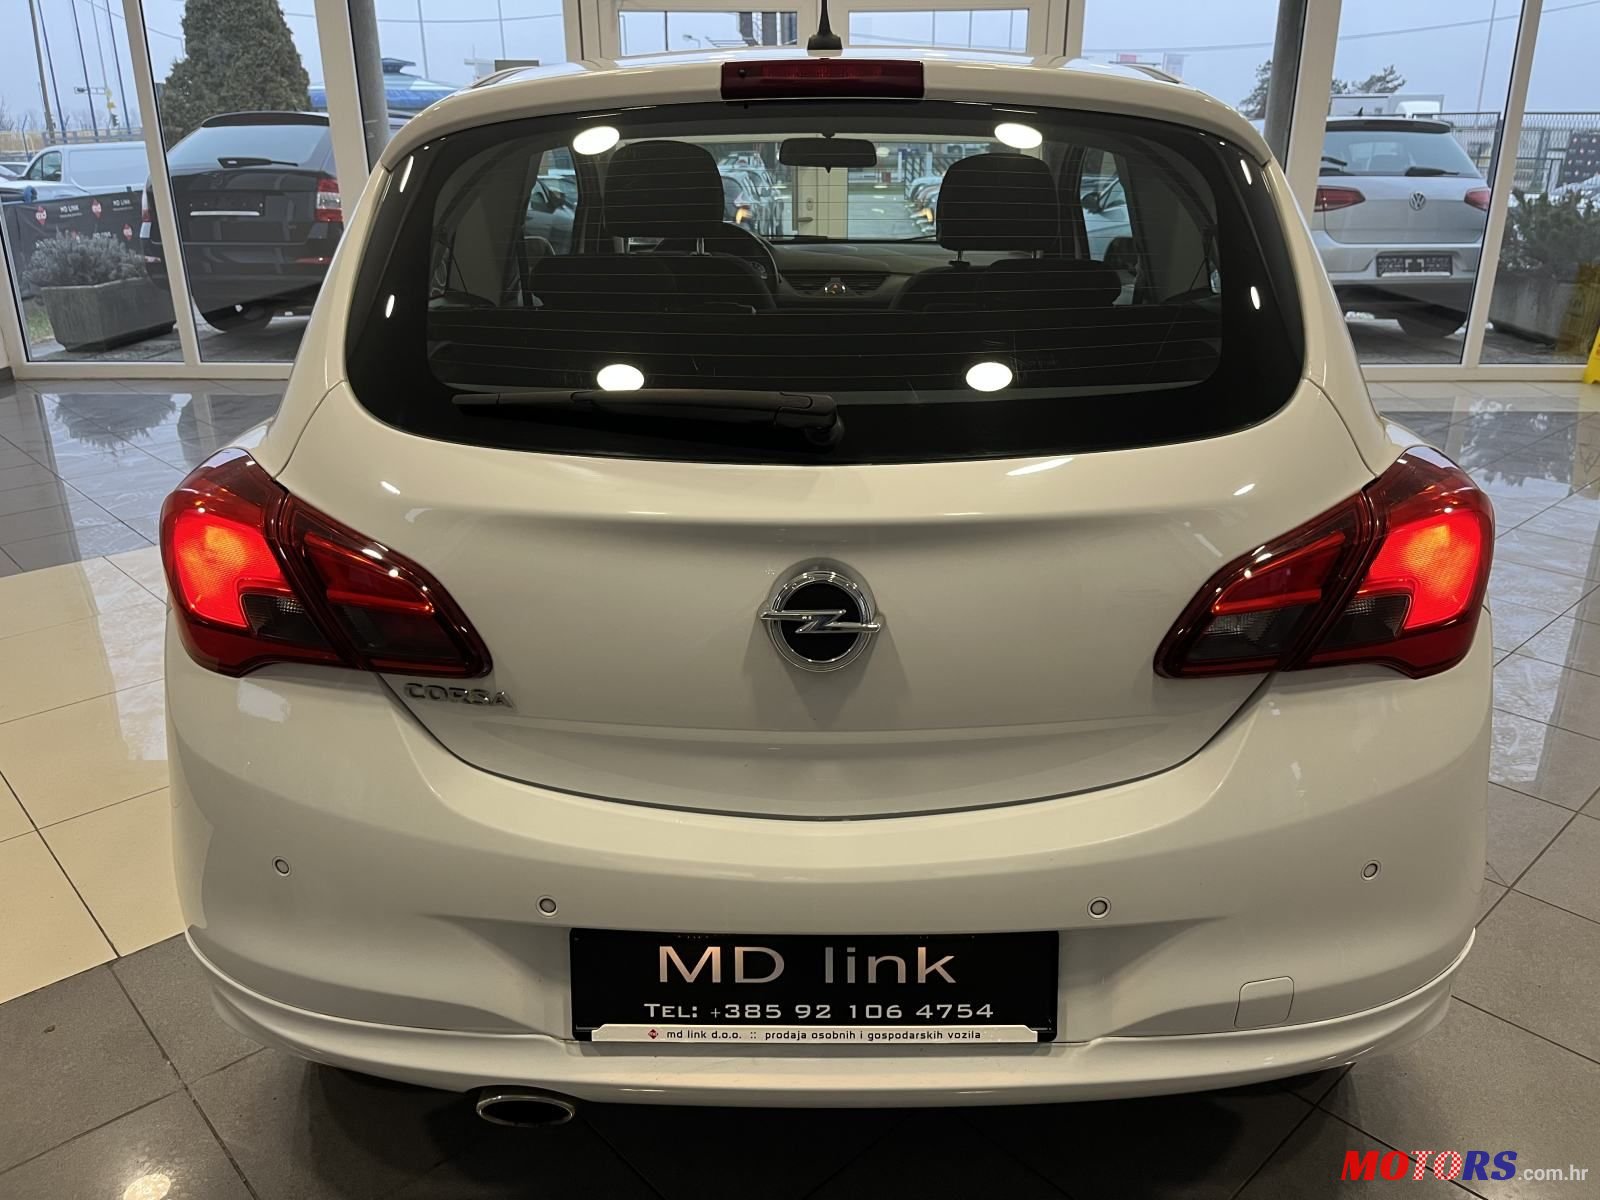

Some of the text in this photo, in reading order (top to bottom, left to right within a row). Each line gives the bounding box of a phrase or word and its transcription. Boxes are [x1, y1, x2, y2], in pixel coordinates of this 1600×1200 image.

[404, 682, 514, 709] CORSA
[659, 945, 957, 984] MD link
[710, 1004, 782, 1019] +385
[794, 1004, 832, 1019] 92
[849, 1004, 903, 1019] 106
[915, 1004, 994, 1019] 4754
[666, 1030, 683, 1039] md
[687, 1030, 707, 1039] link
[711, 1030, 742, 1040] d.o.o.
[765, 1030, 807, 1042] prodaja
[811, 1030, 856, 1040] osobnih
[867, 1030, 943, 1042] gospodarskih
[947, 1030, 982, 1040] vozila
